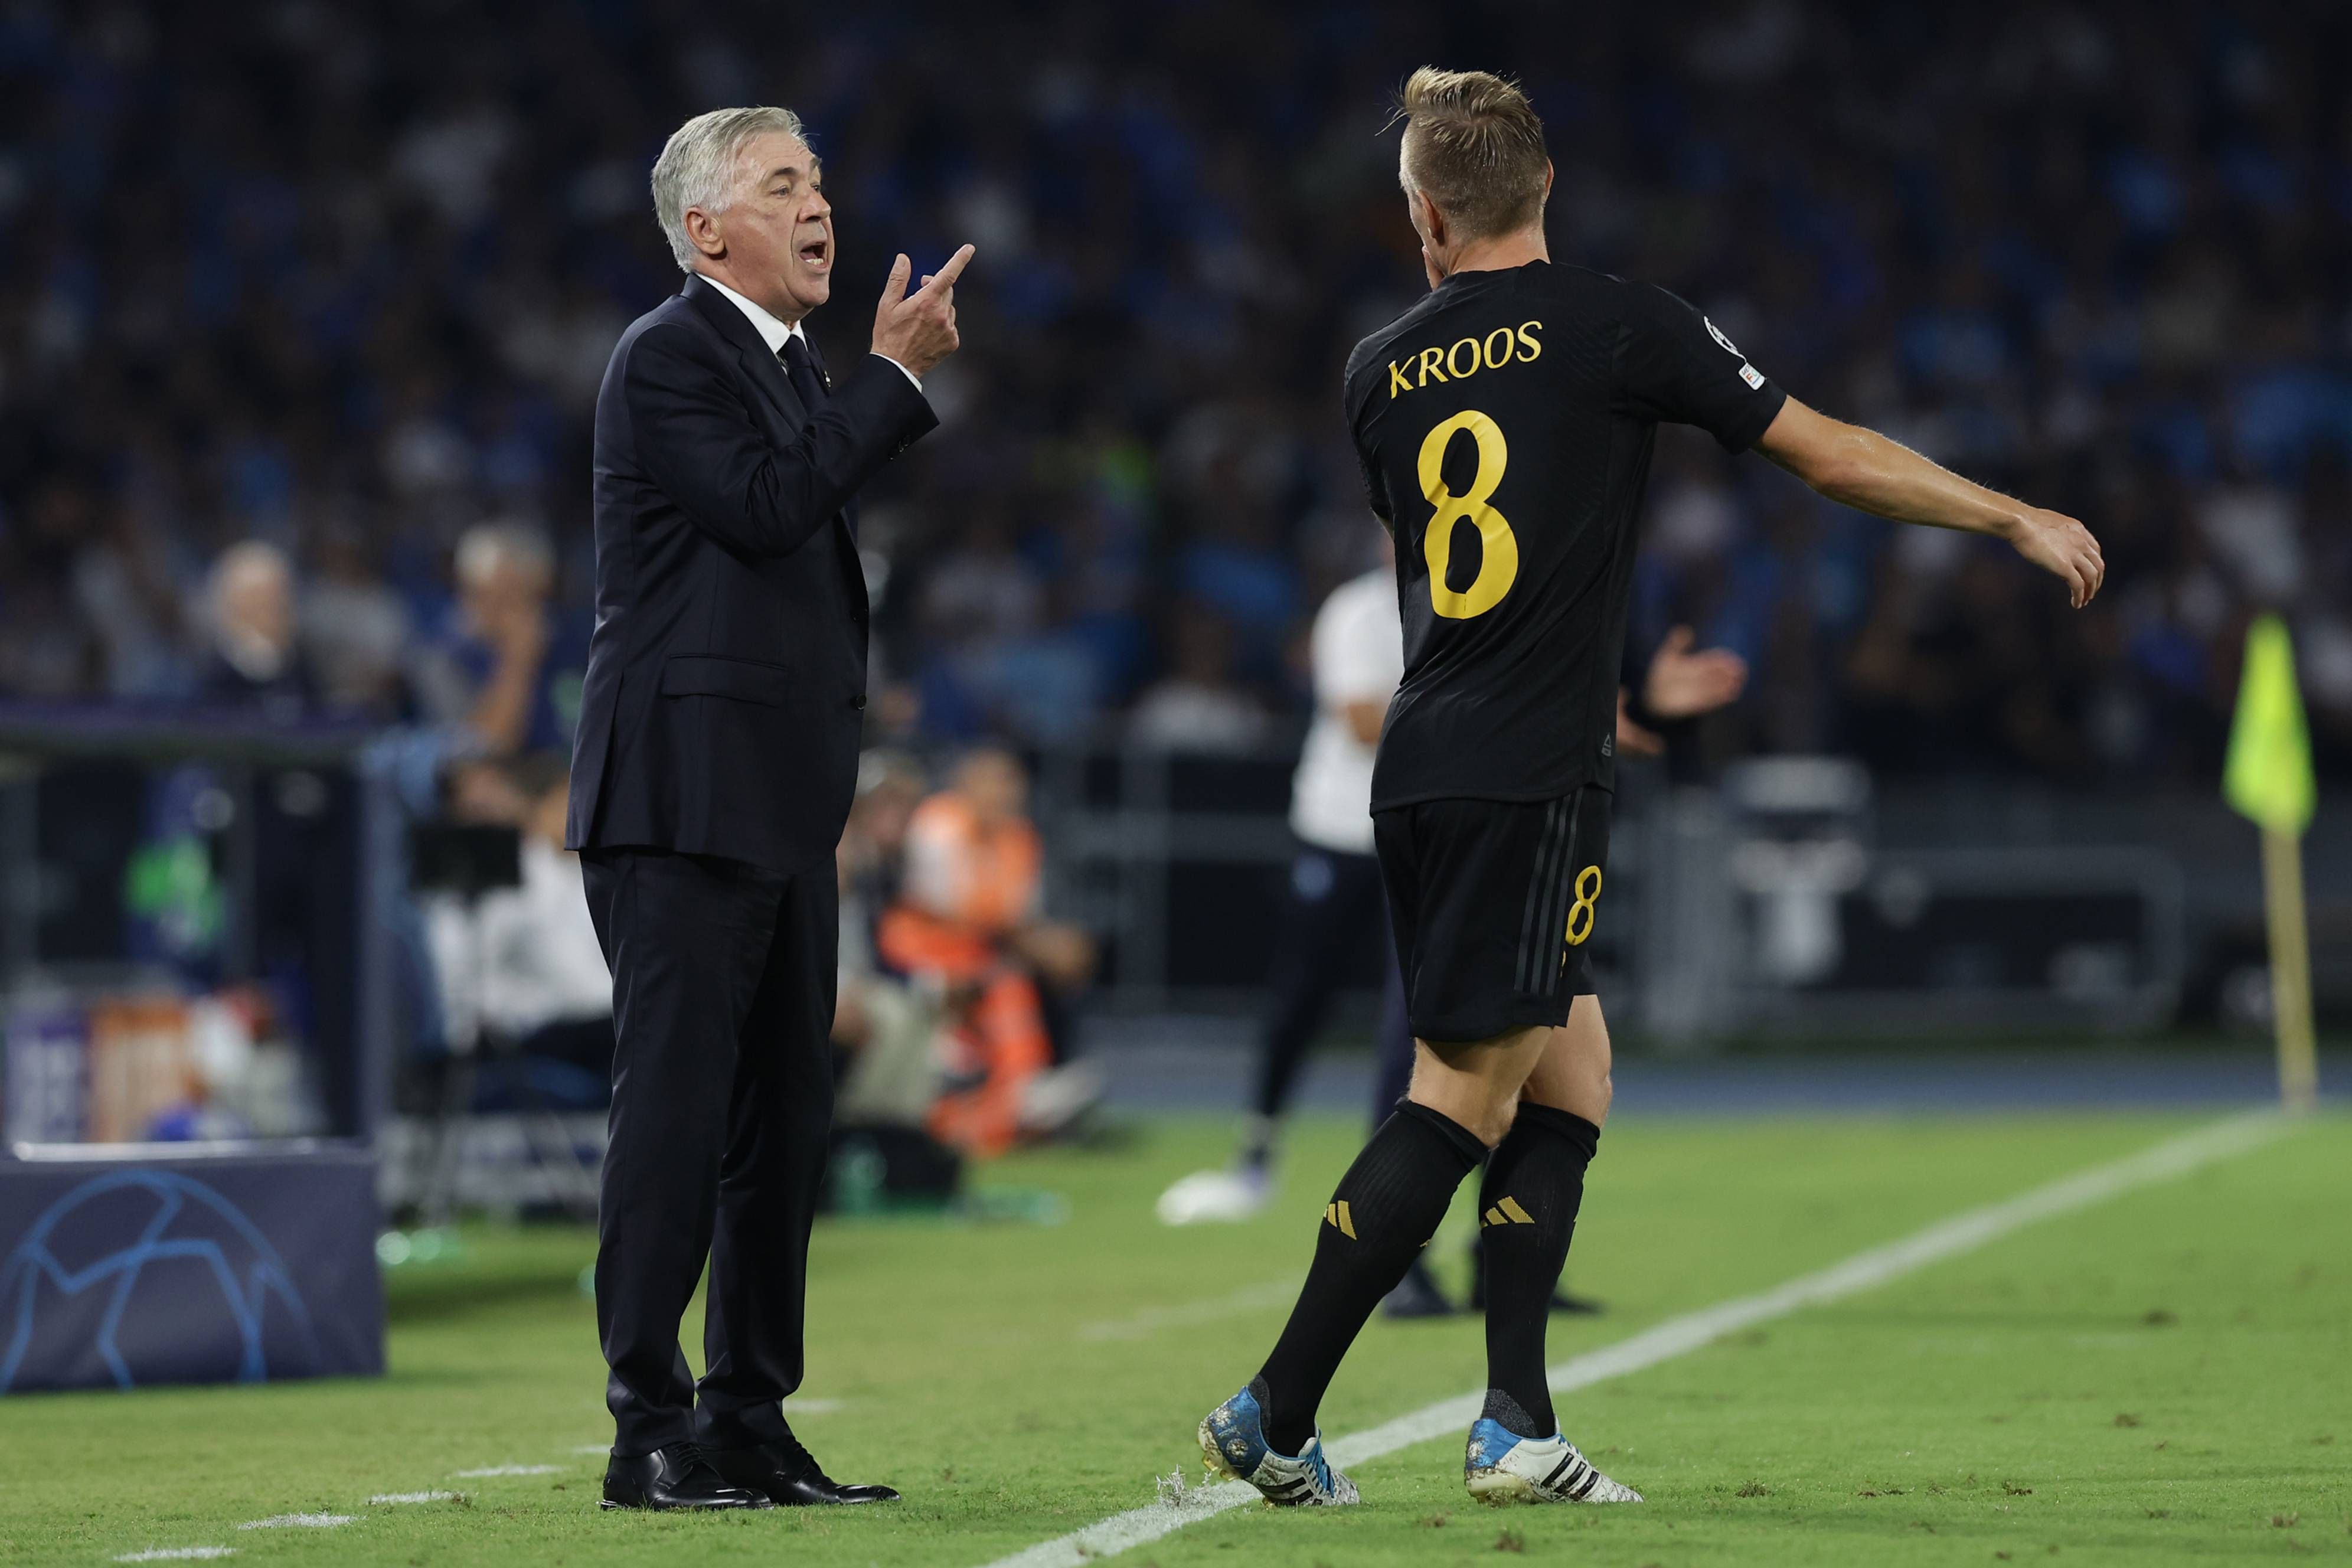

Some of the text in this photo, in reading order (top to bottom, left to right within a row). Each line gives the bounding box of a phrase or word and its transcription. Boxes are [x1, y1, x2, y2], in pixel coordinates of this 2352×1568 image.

[1389, 321, 1543, 399] KROOS
[1417, 410, 1518, 620] 8
[1565, 865, 1602, 945] 8
